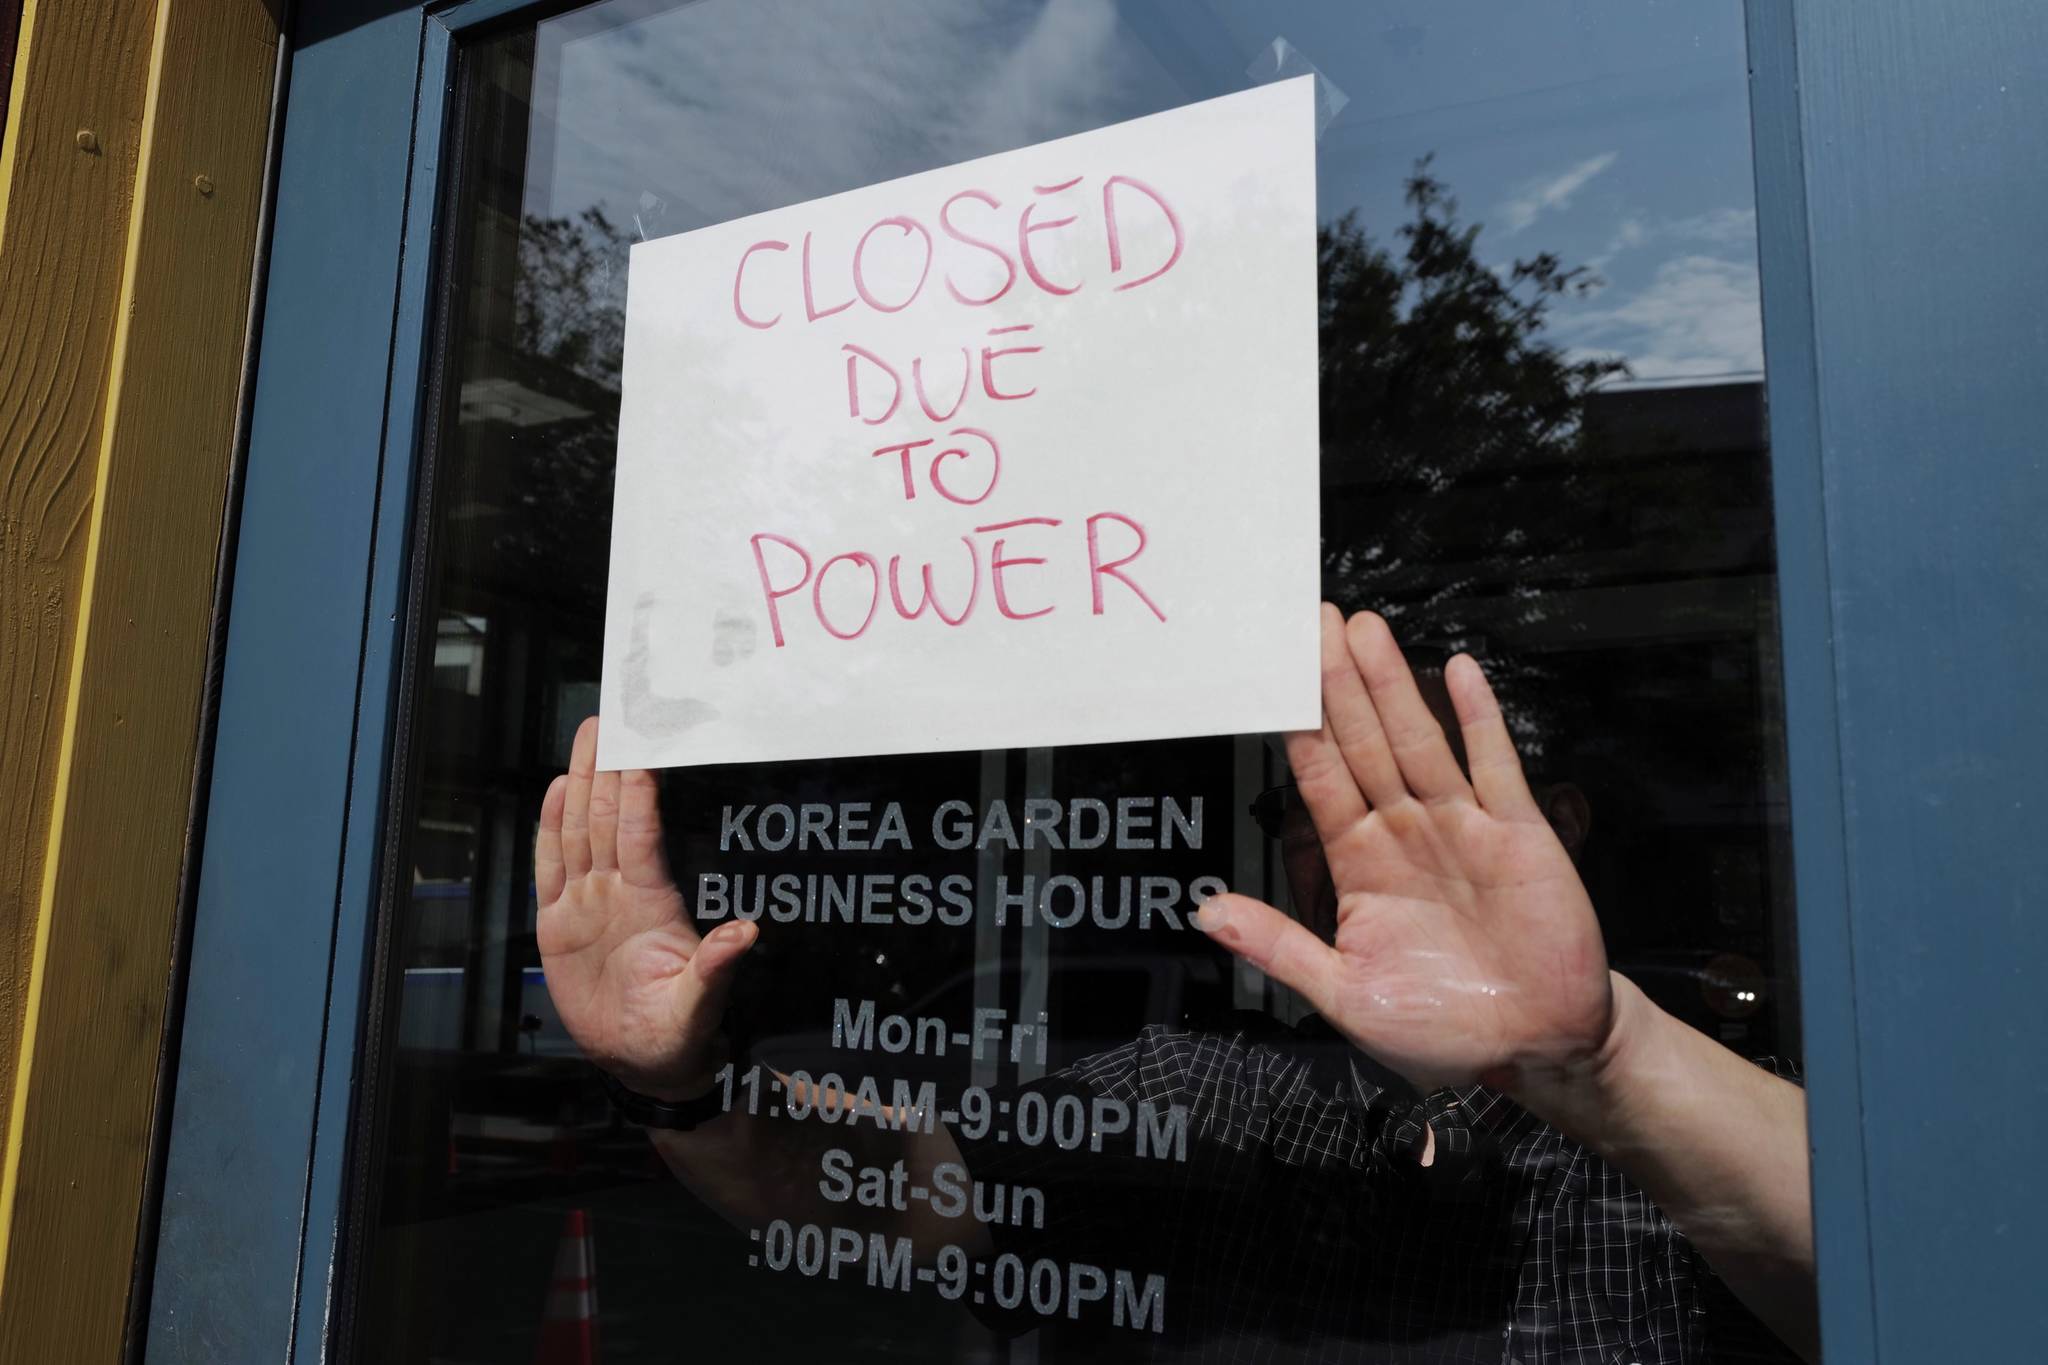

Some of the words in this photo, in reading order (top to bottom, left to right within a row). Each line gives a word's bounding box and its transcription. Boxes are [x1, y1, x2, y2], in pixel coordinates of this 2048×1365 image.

[733, 175, 1185, 329] CLOSED
[841, 324, 1043, 425] DUE
[872, 427, 1000, 506] TO
[750, 512, 1167, 647] POWER
[719, 803, 912, 852] KOREA
[932, 796, 1204, 850] GARDEN
[696, 873, 974, 925] BUSINESS
[995, 875, 1229, 931] HOURS
[832, 999, 1049, 1064] Mon-Fri
[714, 1064, 1188, 1162] 11:00AM-9:00PM
[819, 1150, 1045, 1228] Sat-Sun
